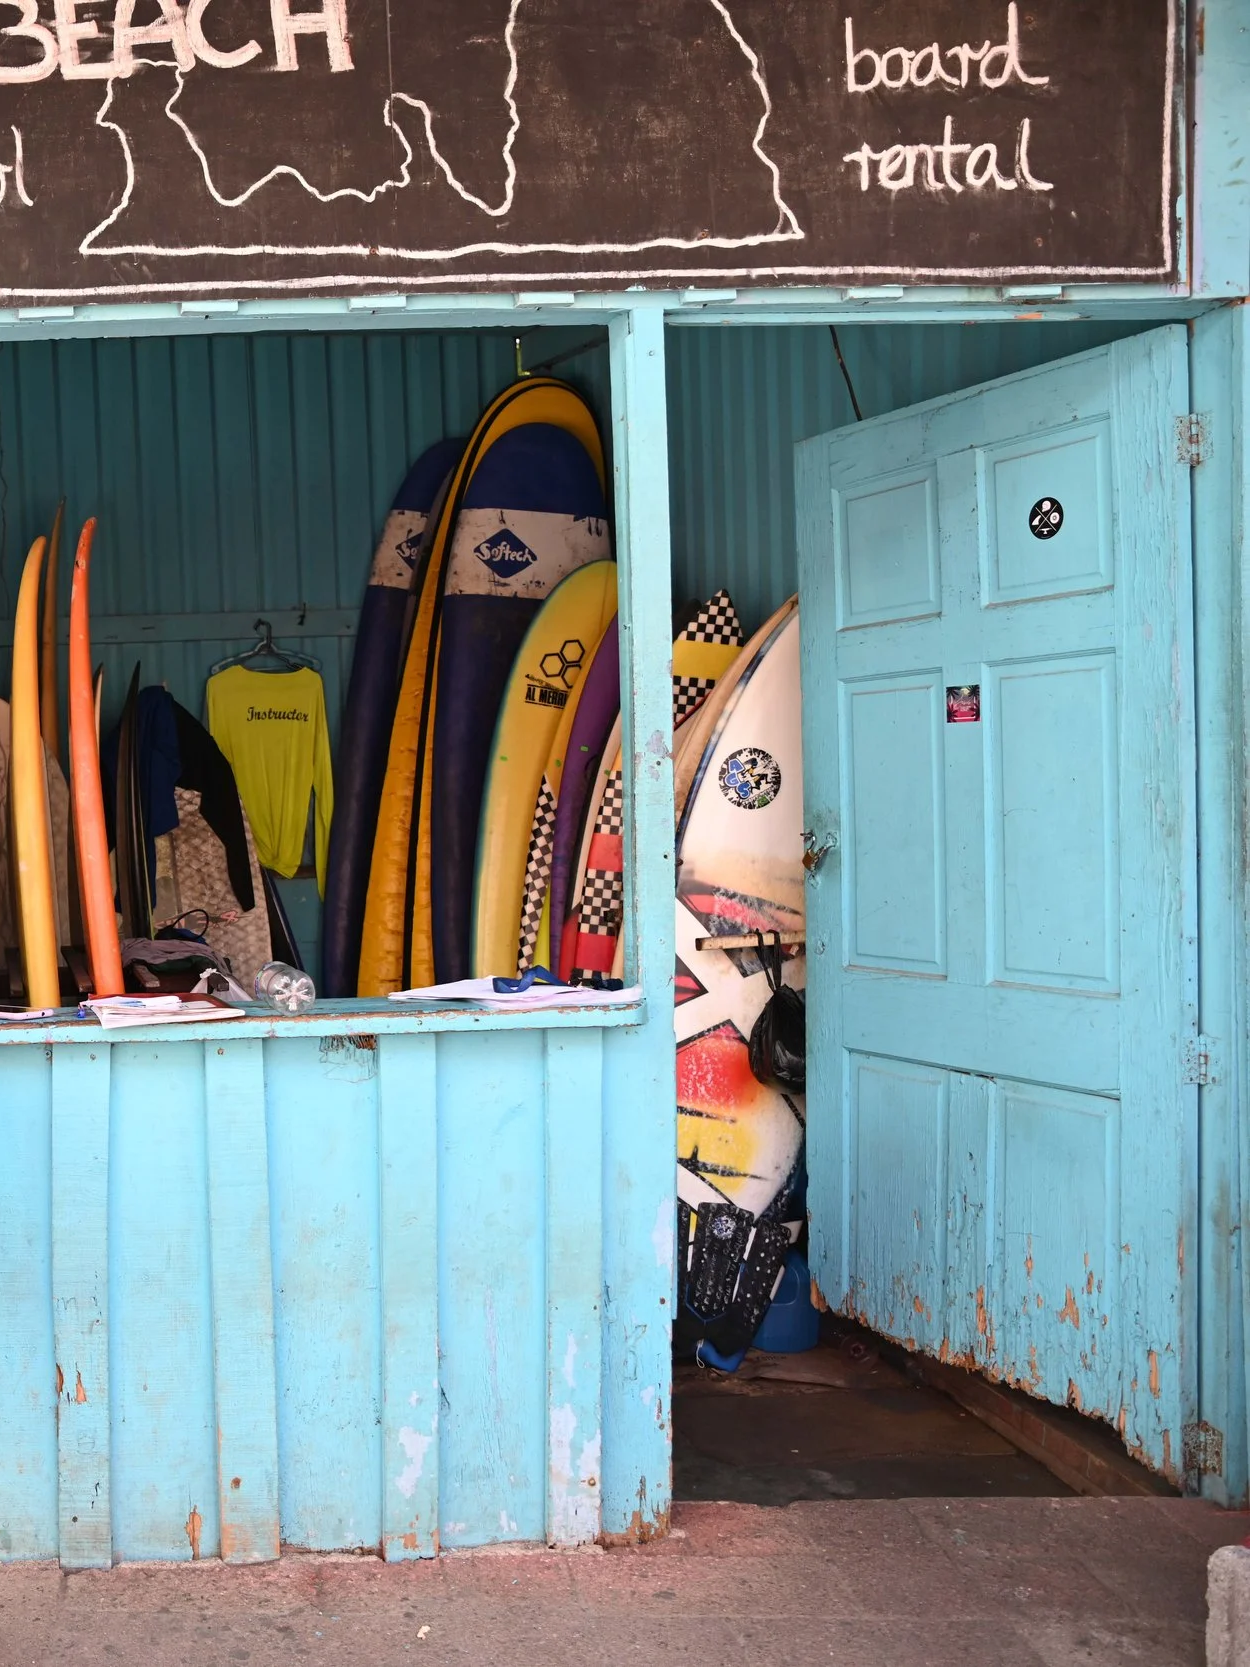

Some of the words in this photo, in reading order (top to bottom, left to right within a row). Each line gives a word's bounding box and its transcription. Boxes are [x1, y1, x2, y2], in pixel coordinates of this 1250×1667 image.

[844, 1, 1049, 93] board
[843, 116, 1055, 192] rental
[474, 541, 534, 562] Softech
[246, 706, 309, 722] Instructor
